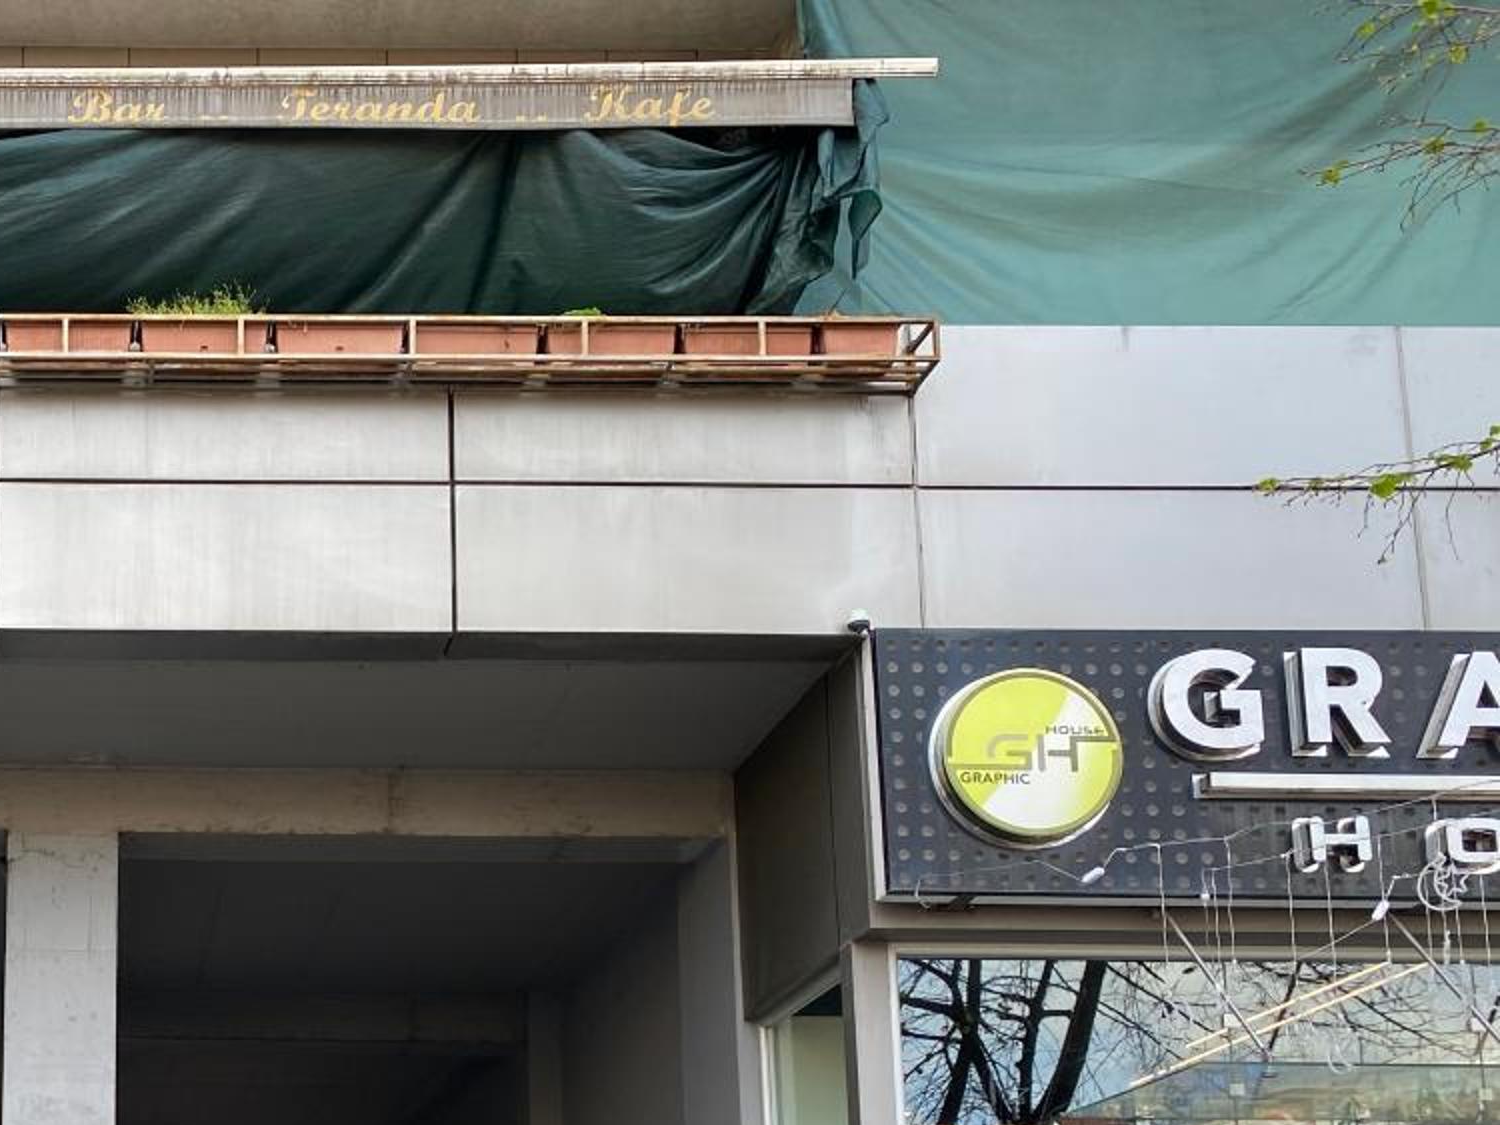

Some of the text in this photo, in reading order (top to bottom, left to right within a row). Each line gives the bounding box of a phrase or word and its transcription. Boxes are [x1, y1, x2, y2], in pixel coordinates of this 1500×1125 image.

[67, 90, 166, 123] Bar
[278, 88, 482, 124] Teranda
[583, 84, 716, 127] Kafe
[1045, 724, 1104, 736] HOUSE
[960, 771, 1031, 785] GRAPHIC
